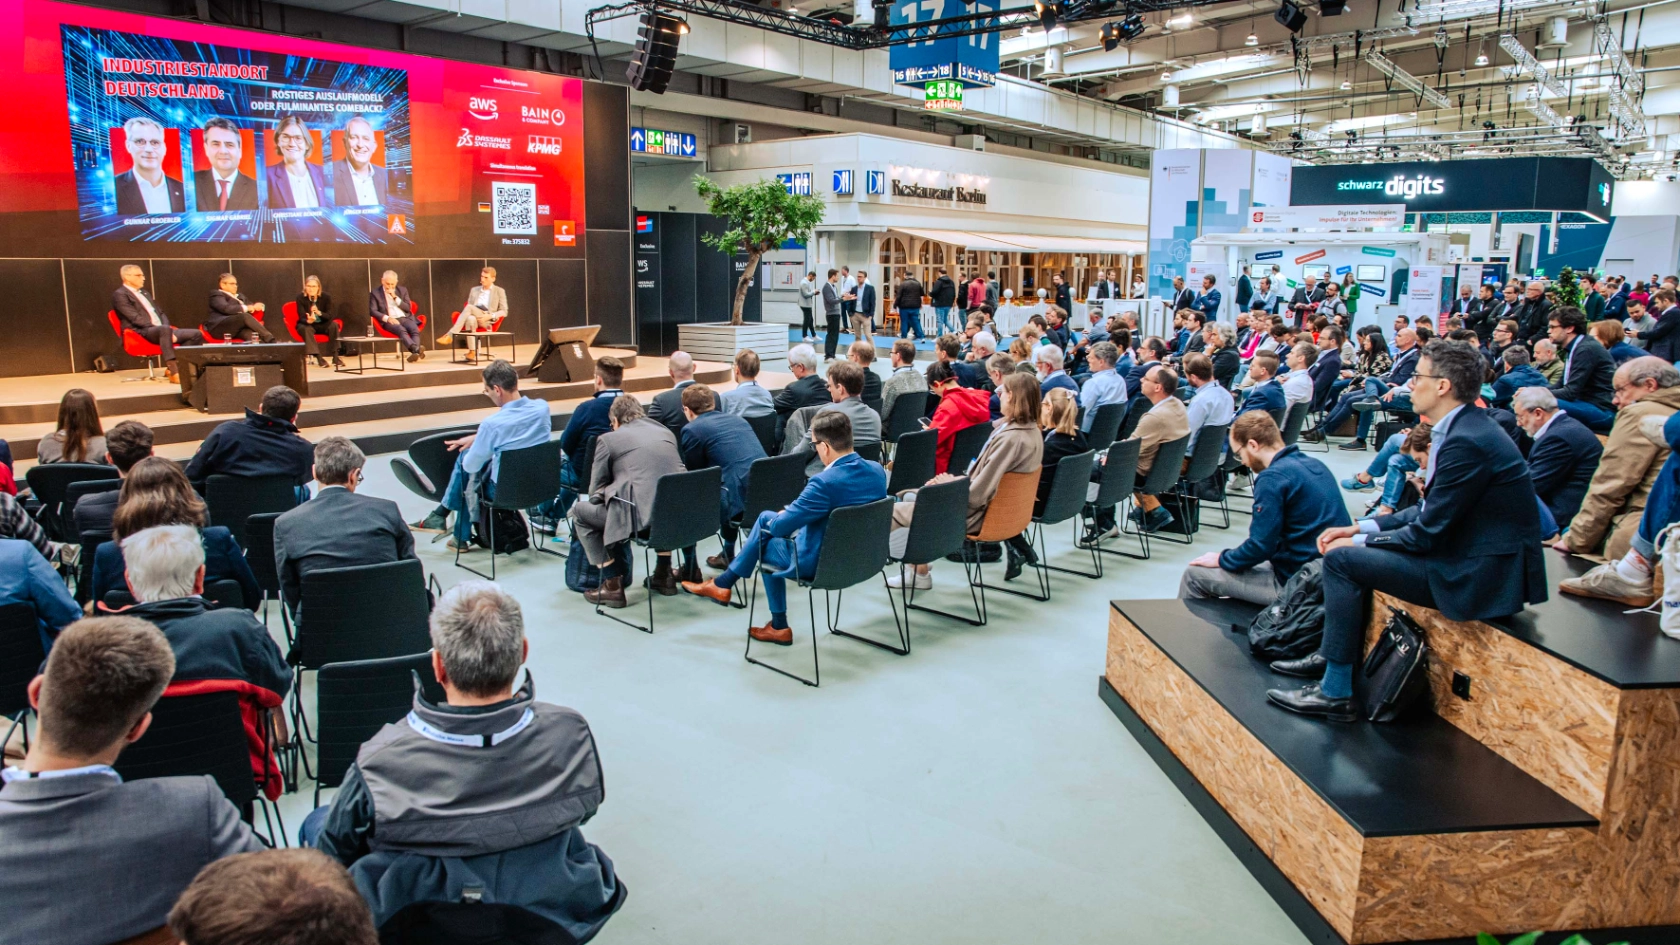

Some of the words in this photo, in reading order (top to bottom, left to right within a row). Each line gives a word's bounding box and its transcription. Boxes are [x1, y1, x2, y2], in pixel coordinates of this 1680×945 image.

[901, 0, 945, 48] 17
[965, 1, 993, 50] 17
[102, 57, 269, 80] INDUSTRIESTANDORT
[895, 71, 905, 80] 16
[940, 66, 950, 76] 18
[104, 80, 225, 100] DEUTSCHLAND:
[271, 89, 315, 100] ROSTIGES
[315, 91, 384, 103] AUSLAUFMODELL
[250, 101, 276, 111] ODER
[276, 102, 335, 112] FULMINANTES
[335, 103, 384, 113] COMEBACK?
[469, 97, 498, 112] aws
[521, 106, 549, 118] BAIN
[474, 135, 512, 144] DASSAULT
[527, 143, 560, 155] KPMG
[892, 179, 954, 201] Restaurant
[956, 187, 987, 204] Berlin
[1337, 180, 1383, 190] schwarz
[1385, 175, 1444, 199] digits
